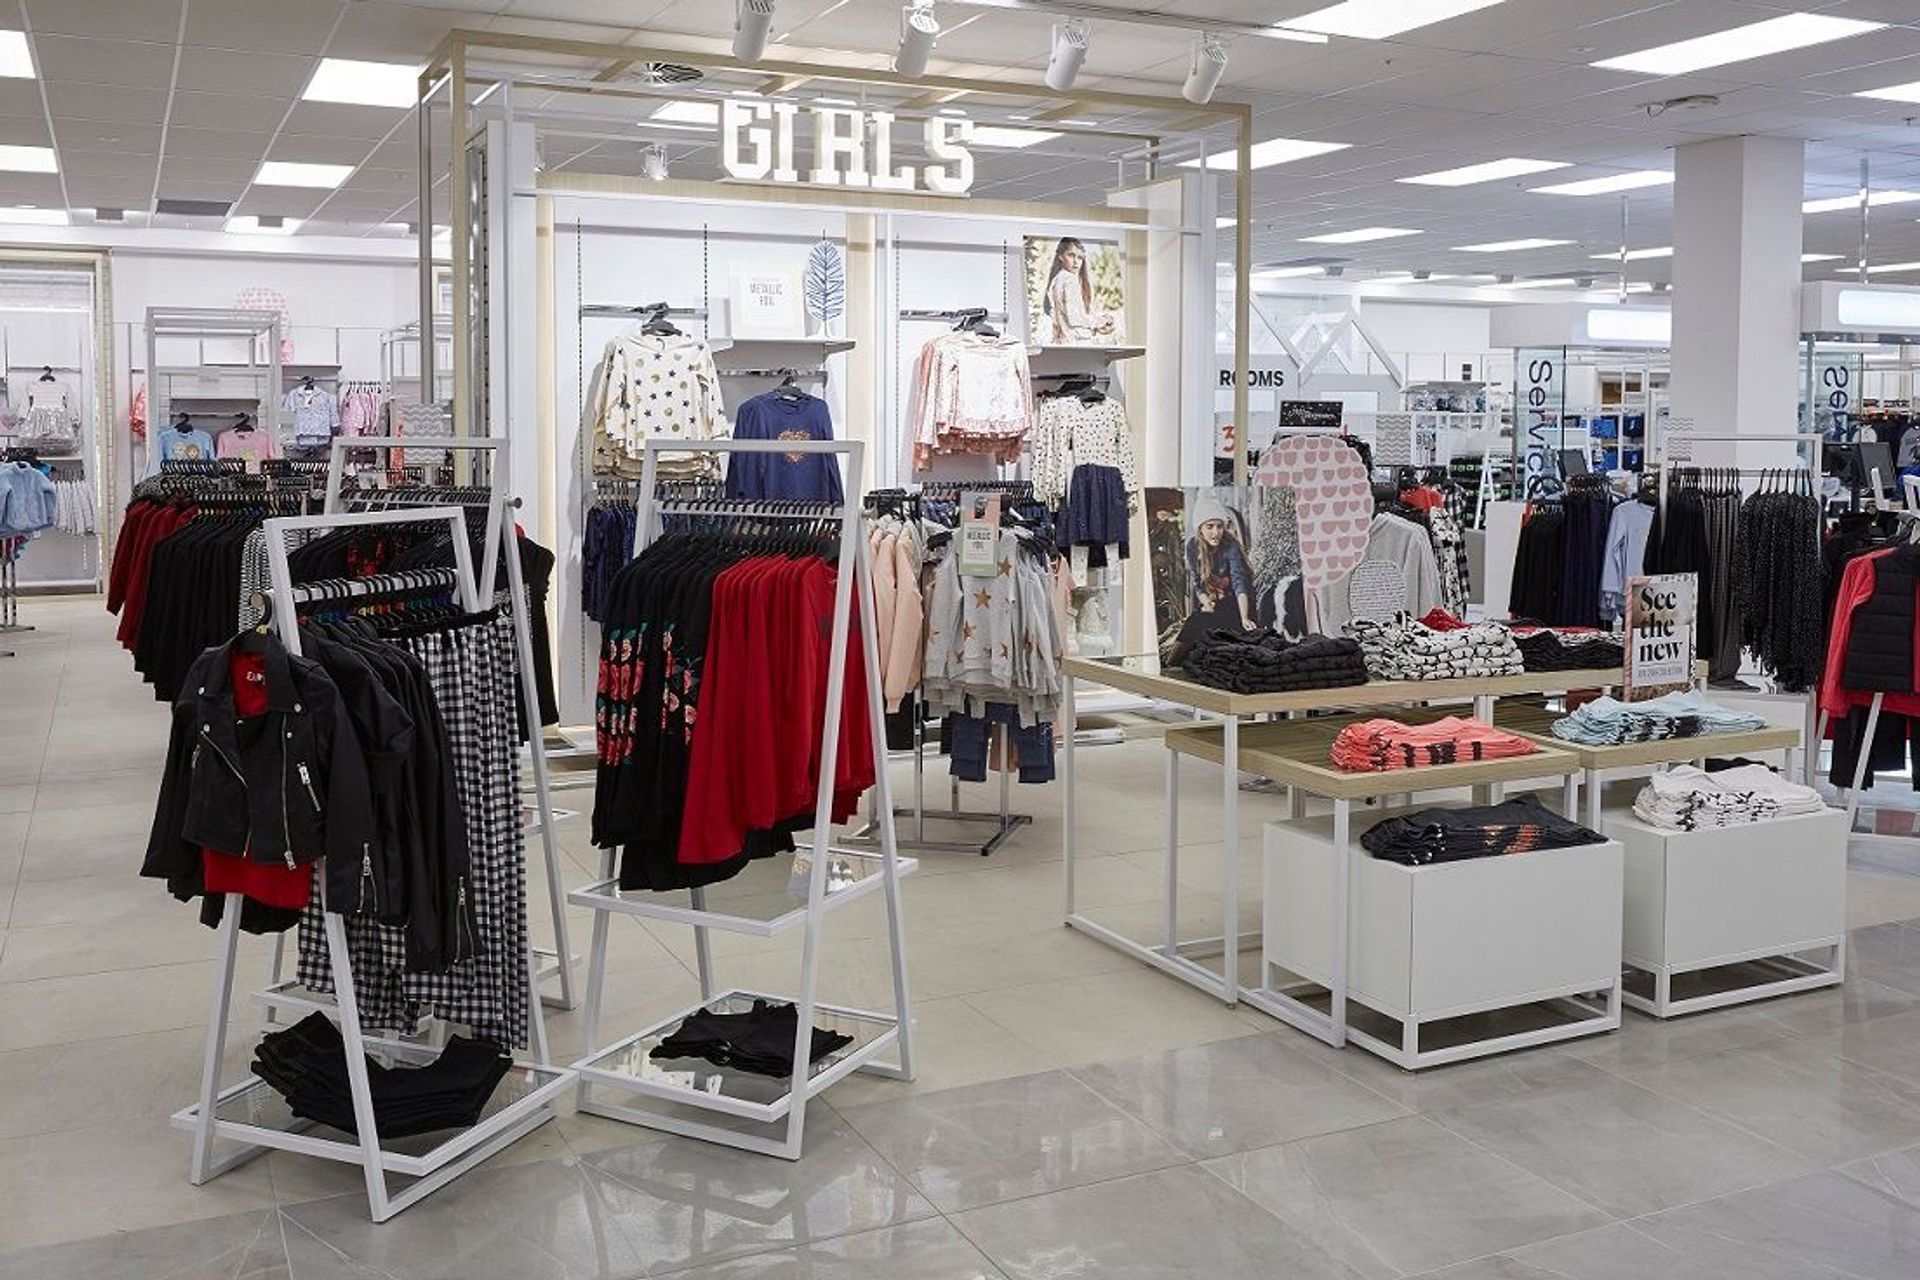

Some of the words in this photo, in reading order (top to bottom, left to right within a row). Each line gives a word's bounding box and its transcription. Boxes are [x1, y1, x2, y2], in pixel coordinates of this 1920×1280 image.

[723, 97, 975, 194] GIRLS
[1219, 369, 1285, 387] ROMS
[1640, 585, 1677, 612] See
[1639, 612, 1675, 640] the
[1639, 641, 1683, 663] new
